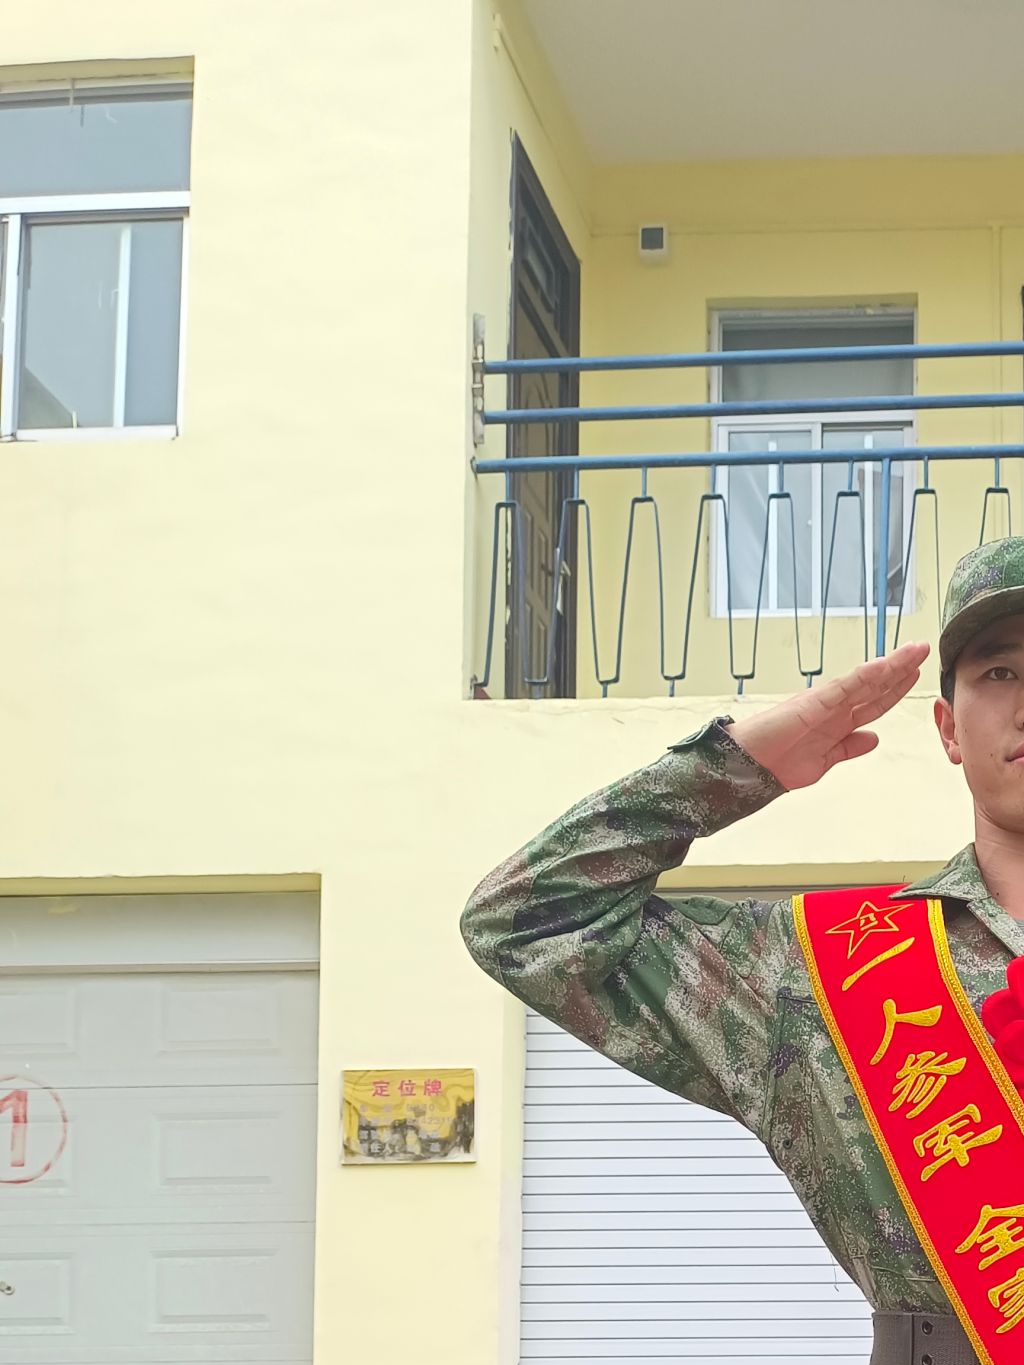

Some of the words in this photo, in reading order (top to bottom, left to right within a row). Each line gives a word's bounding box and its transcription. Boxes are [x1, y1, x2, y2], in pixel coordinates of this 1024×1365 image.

[372, 1078, 443, 1097] 定位牌
[842, 936, 1004, 1182] 一人参军
